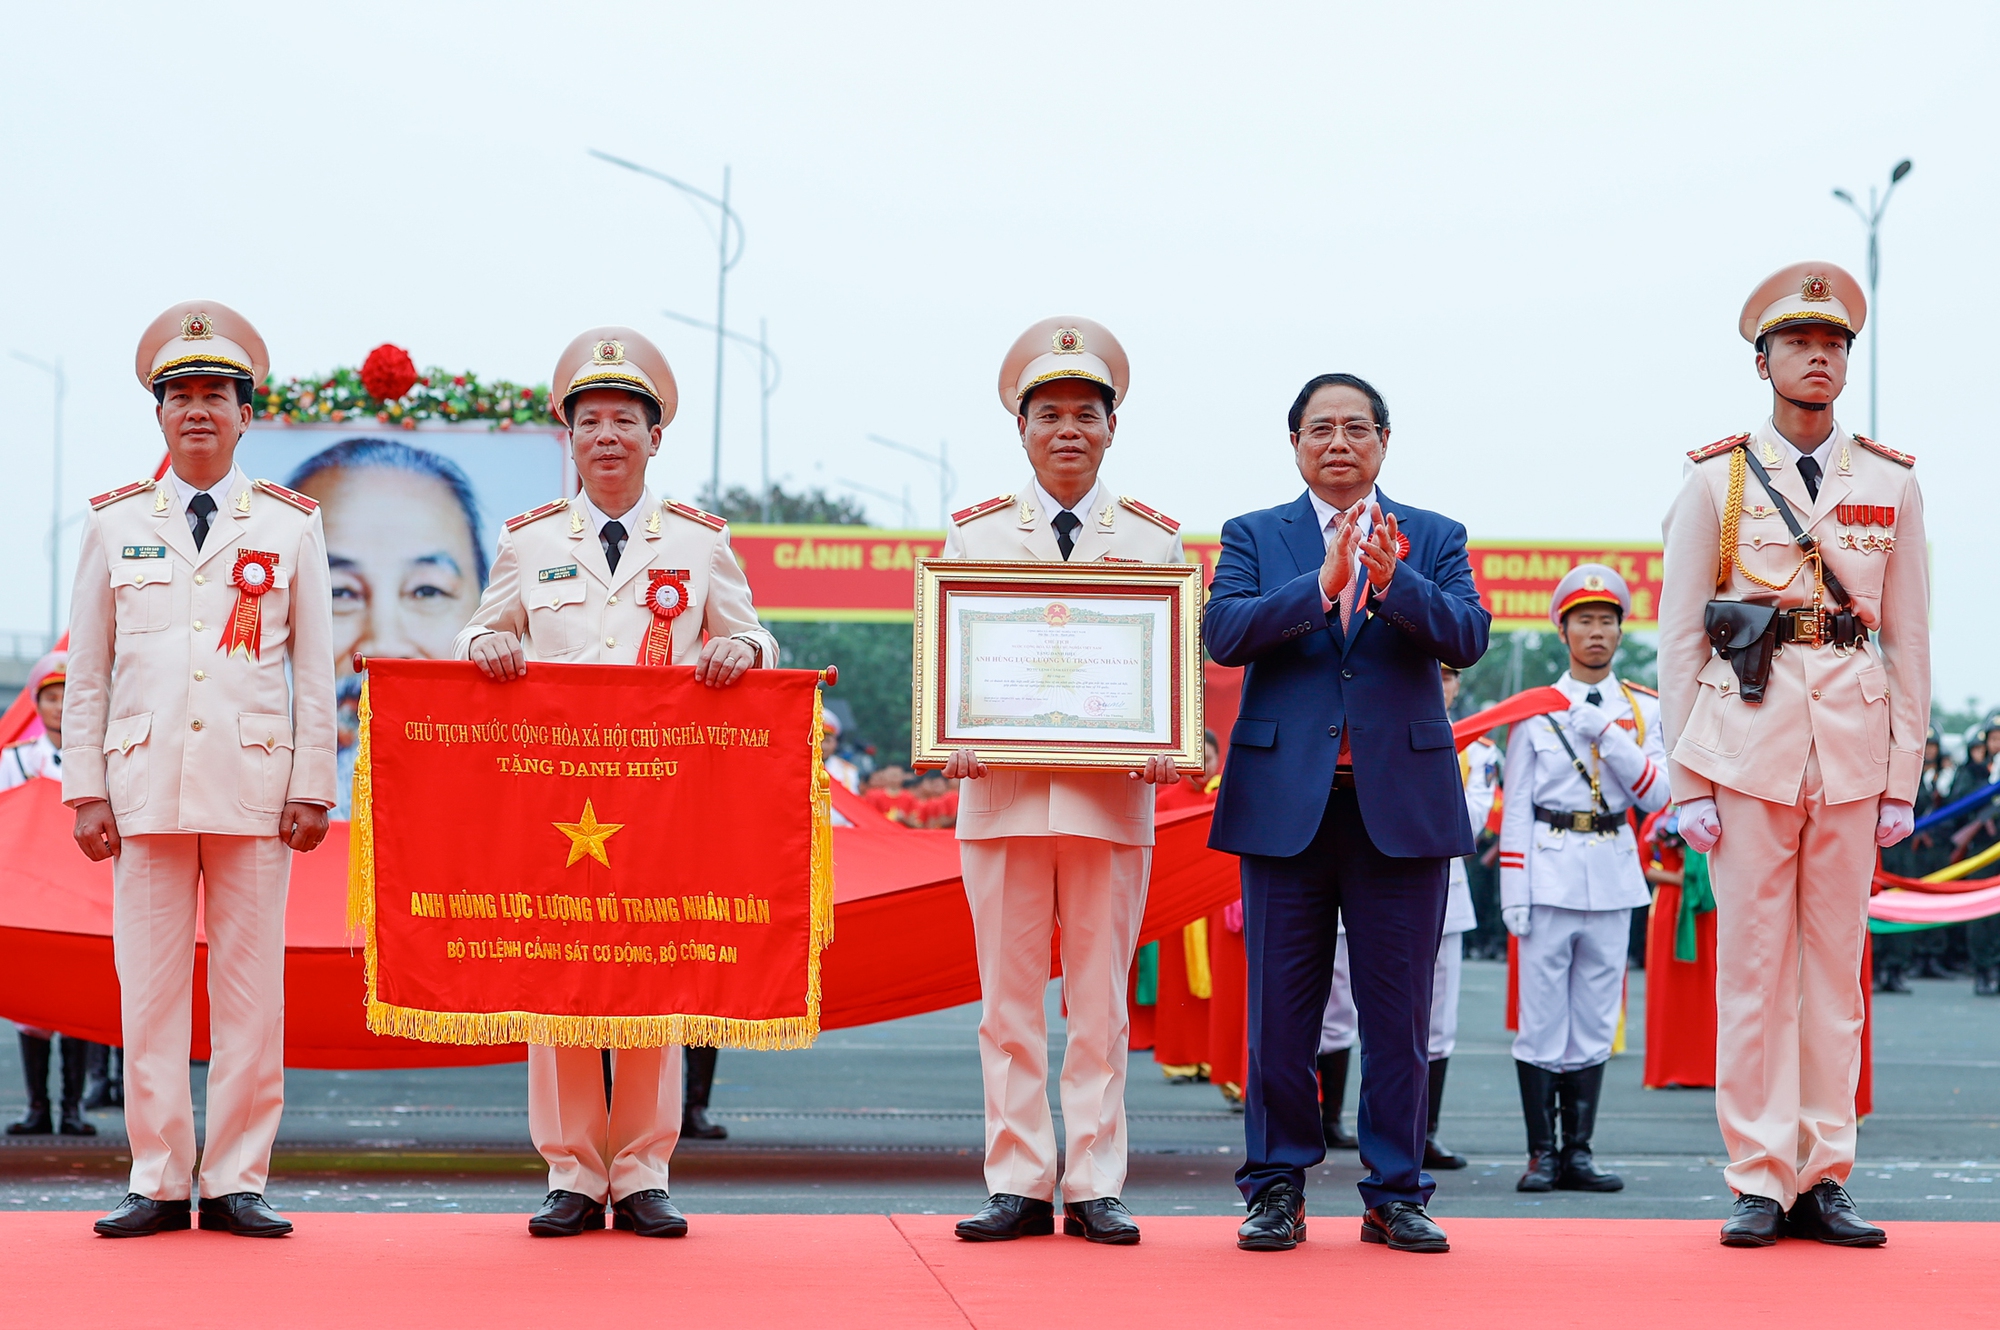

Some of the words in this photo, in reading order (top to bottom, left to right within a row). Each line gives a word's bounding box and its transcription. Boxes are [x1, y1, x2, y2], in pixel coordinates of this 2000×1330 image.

[1100, 656, 1122, 665] NHÂN
[404, 715, 433, 741] CHỦ
[435, 723, 469, 747] TỊCH
[471, 717, 509, 743] NƯỚC
[511, 718, 549, 748] CỘNG
[551, 722, 581, 746] HÒA
[581, 722, 601, 747] XÃ
[603, 722, 628, 752] HỘI
[630, 721, 659, 748] CHỦ
[661, 721, 705, 747] NGHĨA
[706, 721, 738, 750] VIỆT
[739, 728, 770, 748] NAM
[496, 753, 555, 776] TẶNG
[559, 760, 622, 777] DANH
[626, 757, 679, 781] HIỆU
[410, 891, 447, 919] ANH
[449, 889, 498, 919] HÙNG
[500, 891, 534, 923] LỰC
[536, 893, 594, 926] LƯỢNG
[595, 892, 619, 923] VŨ
[621, 897, 681, 923] TRANG
[681, 890, 731, 922] NHÂN
[733, 893, 771, 924] DÂN
[447, 937, 466, 963] BỘ
[468, 939, 487, 959] TƯ
[488, 936, 522, 963] LỆNH
[524, 935, 562, 960] CẢNH
[564, 940, 589, 962] SÁT
[592, 944, 612, 963] CƠ
[614, 941, 658, 967] ĐỘNG,
[659, 940, 677, 967] BỘ
[679, 938, 716, 962] CÔNG
[718, 945, 738, 964] AN
